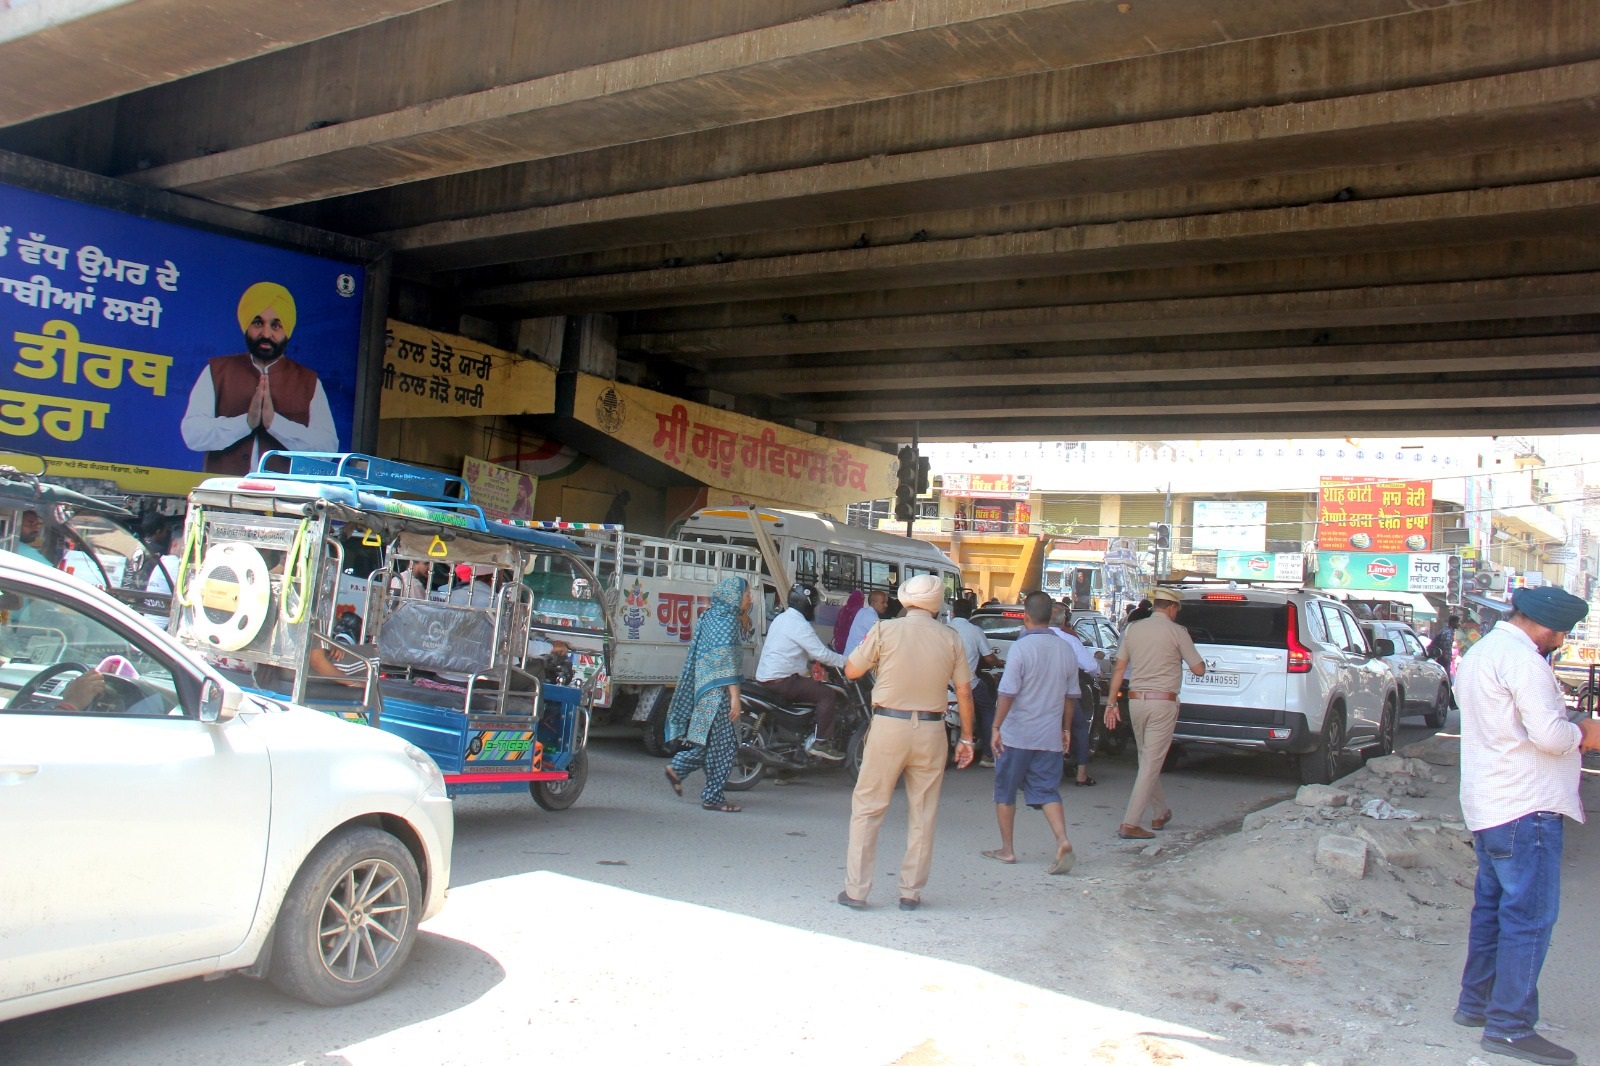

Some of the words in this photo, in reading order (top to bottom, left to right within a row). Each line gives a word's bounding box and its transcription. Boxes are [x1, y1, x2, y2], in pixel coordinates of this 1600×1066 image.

[17, 231, 70, 271] ਵੱਧ
[76, 245, 150, 285] ਉਮਰ
[156, 259, 181, 292] ਦੇ
[0, 275, 97, 315] ਾਬੀਆਂ
[102, 296, 164, 328] ਲਈ
[13, 319, 174, 397] ਤੀਰਥ
[397, 338, 428, 364] ਨਾਲ
[458, 354, 493, 381] ਯਾਰੀ
[398, 372, 428, 397] ਨਾਲ
[454, 383, 485, 408] ਯਾਰੀ
[0, 388, 111, 442] ਤਰਾ
[691, 422, 738, 478] ਗੁਰੂ
[741, 427, 829, 484] ਰਵਿਦਾਸ
[1323, 487, 1346, 505] शाह
[1347, 484, 1373, 503] कोटी
[1368, 565, 1395, 574] Limca
[1414, 557, 1441, 573] ਜੋਹਰ
[656, 592, 695, 643] ਗੁਰੂ
[483, 739, 531, 752] E-TIGER
